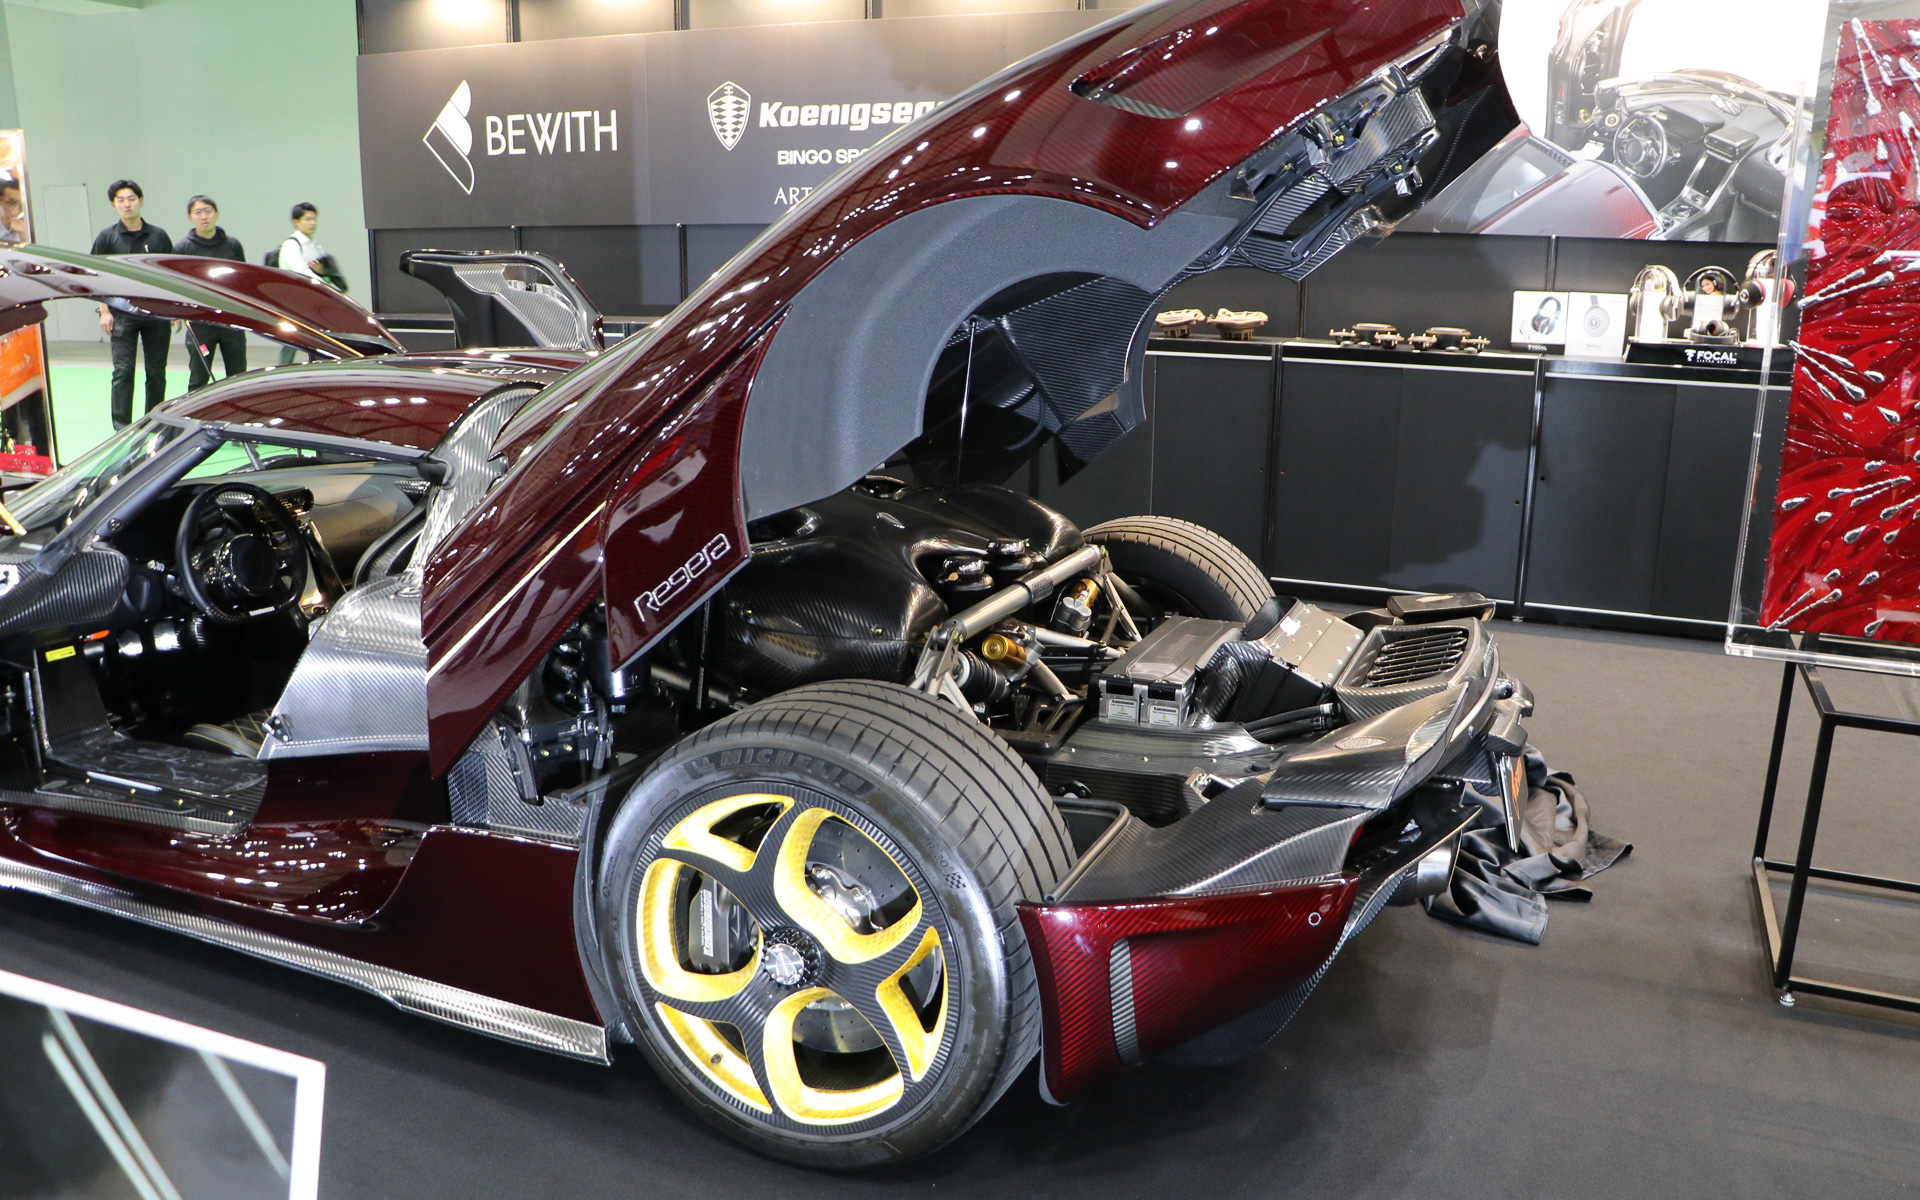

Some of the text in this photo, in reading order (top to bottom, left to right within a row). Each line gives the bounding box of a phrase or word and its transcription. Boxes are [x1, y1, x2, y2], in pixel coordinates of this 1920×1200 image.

[485, 109, 618, 156] BEWITH
[777, 148, 833, 165] BINGO
[1696, 350, 1737, 361] FOCAL
[633, 533, 732, 622] Regera
[720, 748, 866, 793] MICHELIN
